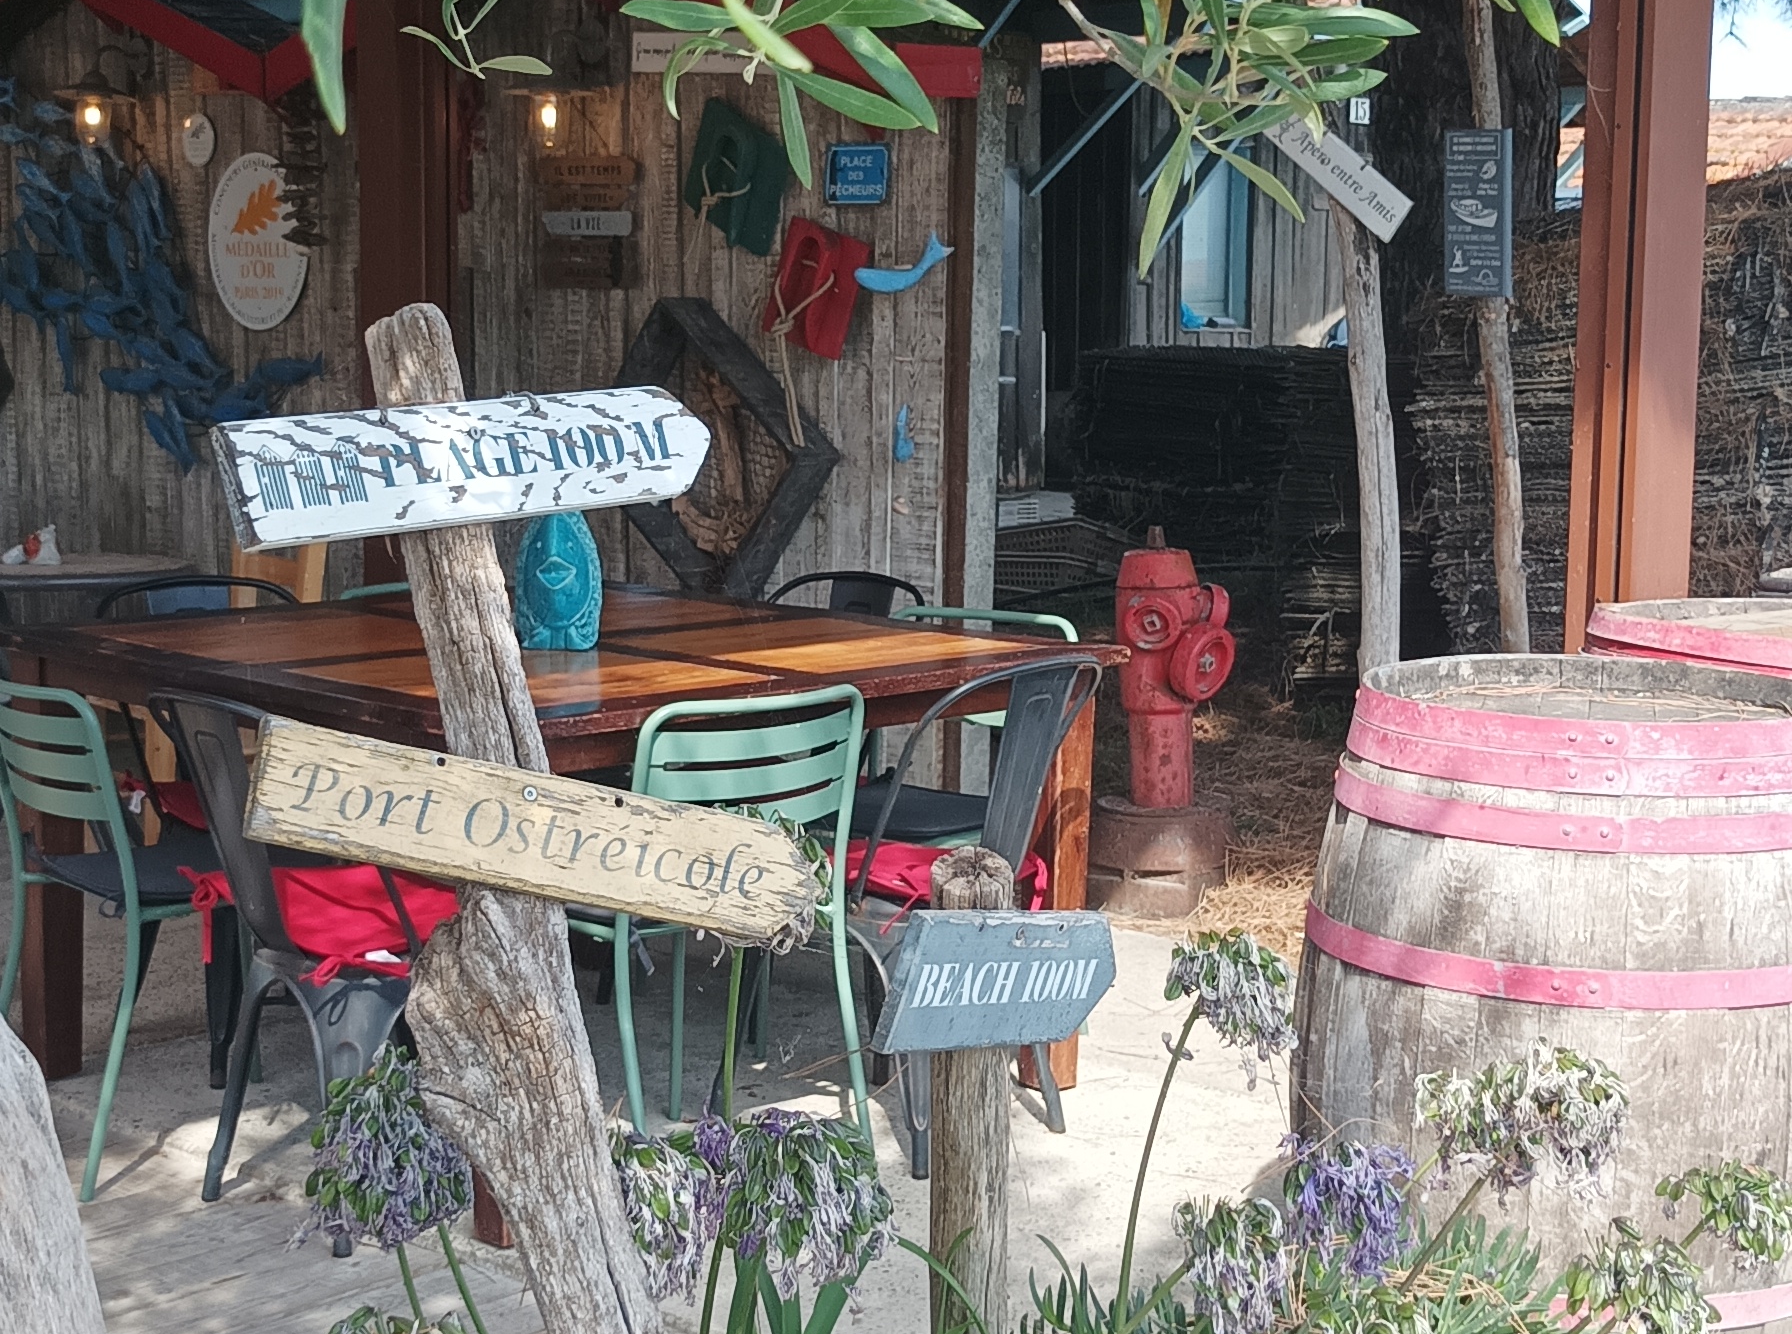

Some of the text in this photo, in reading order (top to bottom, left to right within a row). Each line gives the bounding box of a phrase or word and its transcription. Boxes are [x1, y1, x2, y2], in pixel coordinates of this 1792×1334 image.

[1355, 100, 1366, 121] 15
[840, 155, 873, 167] PLACE
[848, 171, 864, 181] DES
[829, 182, 883, 196] PÊCHEURS
[1331, 164, 1363, 195] entre
[1358, 191, 1397, 224] Amis
[239, 259, 276, 279] D'OR
[377, 430, 538, 488] PLAGE
[289, 762, 765, 901] Port Ostréicole
[909, 958, 1099, 1009] BEACH 100M
